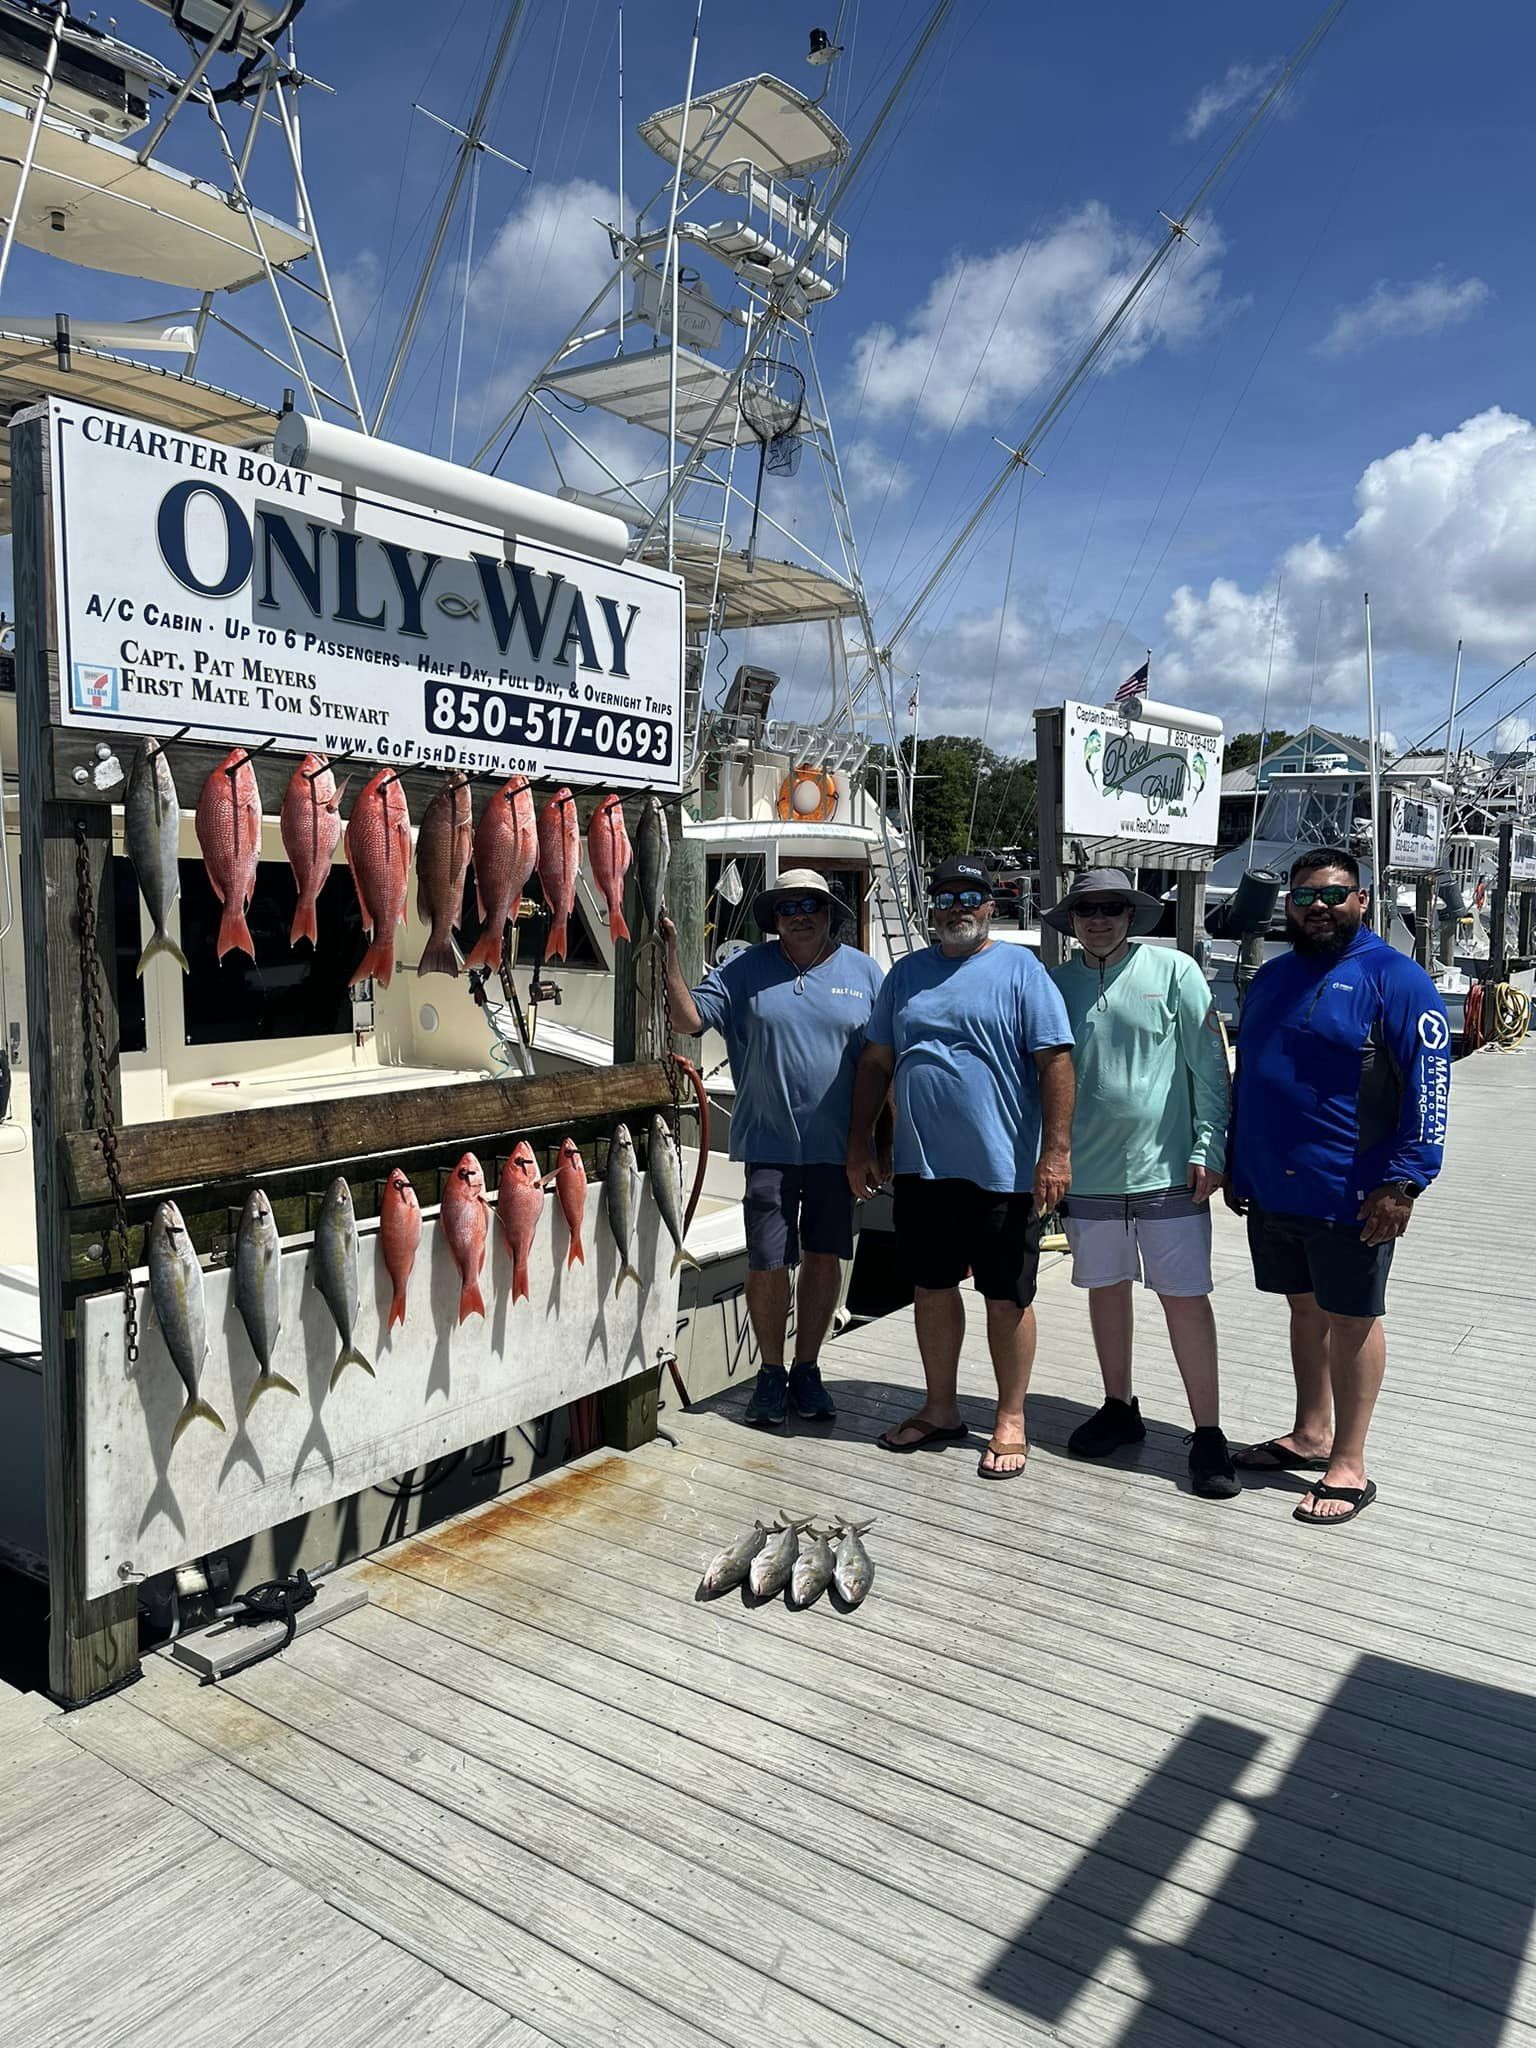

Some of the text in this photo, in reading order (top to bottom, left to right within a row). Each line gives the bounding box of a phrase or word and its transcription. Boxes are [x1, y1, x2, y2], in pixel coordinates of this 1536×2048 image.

[82, 416, 312, 496] CHARTER BOAT
[156, 479, 640, 679] ONLY WAY
[85, 594, 134, 622] A/C
[143, 604, 202, 633] CABIN
[284, 629, 296, 649] 6
[304, 632, 400, 668] PASSENGERS
[568, 682, 579, 699] &
[584, 685, 642, 711] OVERNIGHT
[645, 696, 673, 716] TRIPS
[193, 650, 234, 677] PAT
[242, 657, 317, 690] MEYERS
[120, 667, 389, 727] FIRST MATE TOM STEWART
[432, 687, 669, 761] 850-517-0693
[1419, 1084, 1427, 1113] PRO
[1433, 1055, 1448, 1146] MAGELLAN
